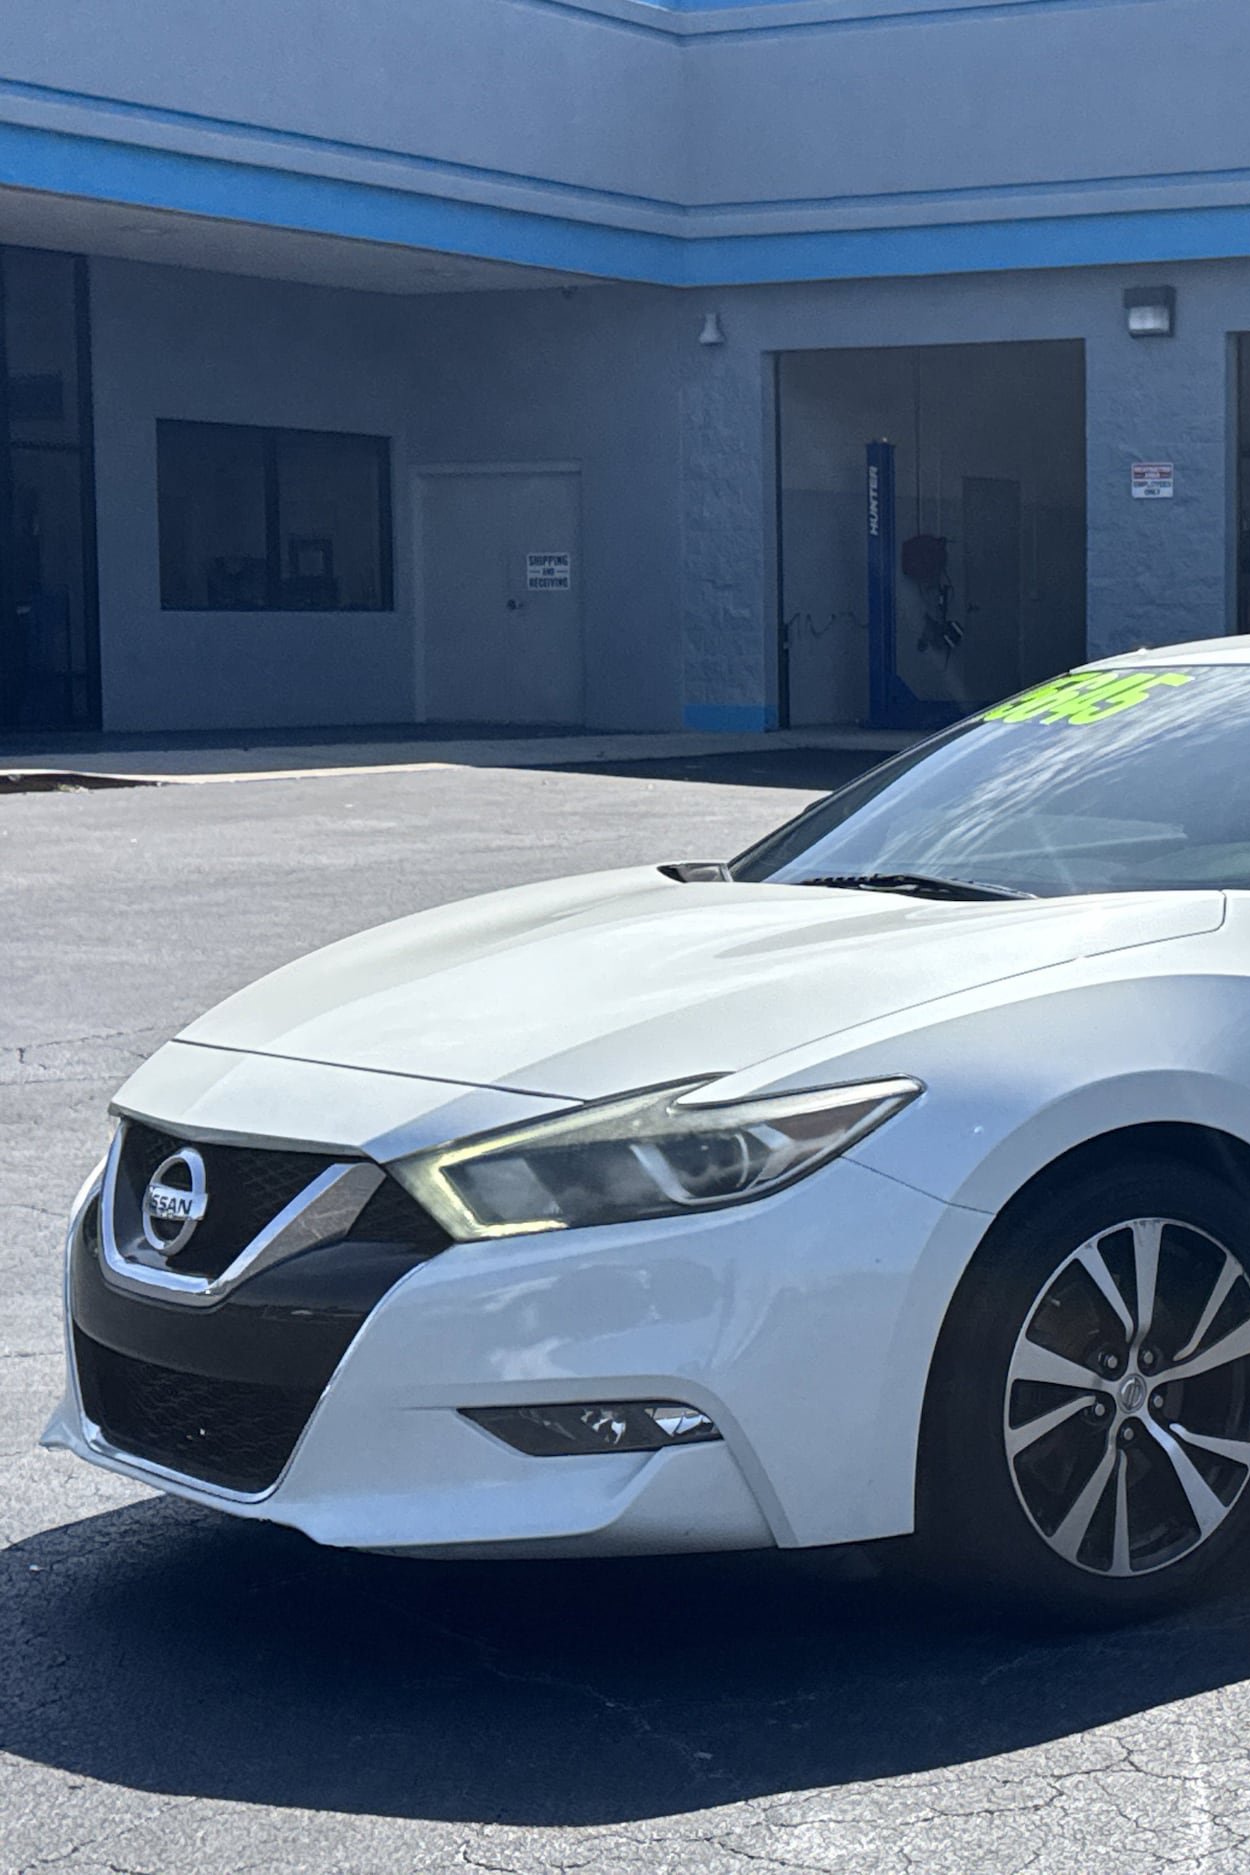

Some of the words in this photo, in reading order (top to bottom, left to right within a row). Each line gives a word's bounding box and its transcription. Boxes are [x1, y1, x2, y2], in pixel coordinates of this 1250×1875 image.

[869, 465, 879, 535] HUNTER
[528, 555, 569, 567] SHIPPING
[528, 577, 569, 589] RECEIVING
[146, 1190, 193, 1216] SSAN
